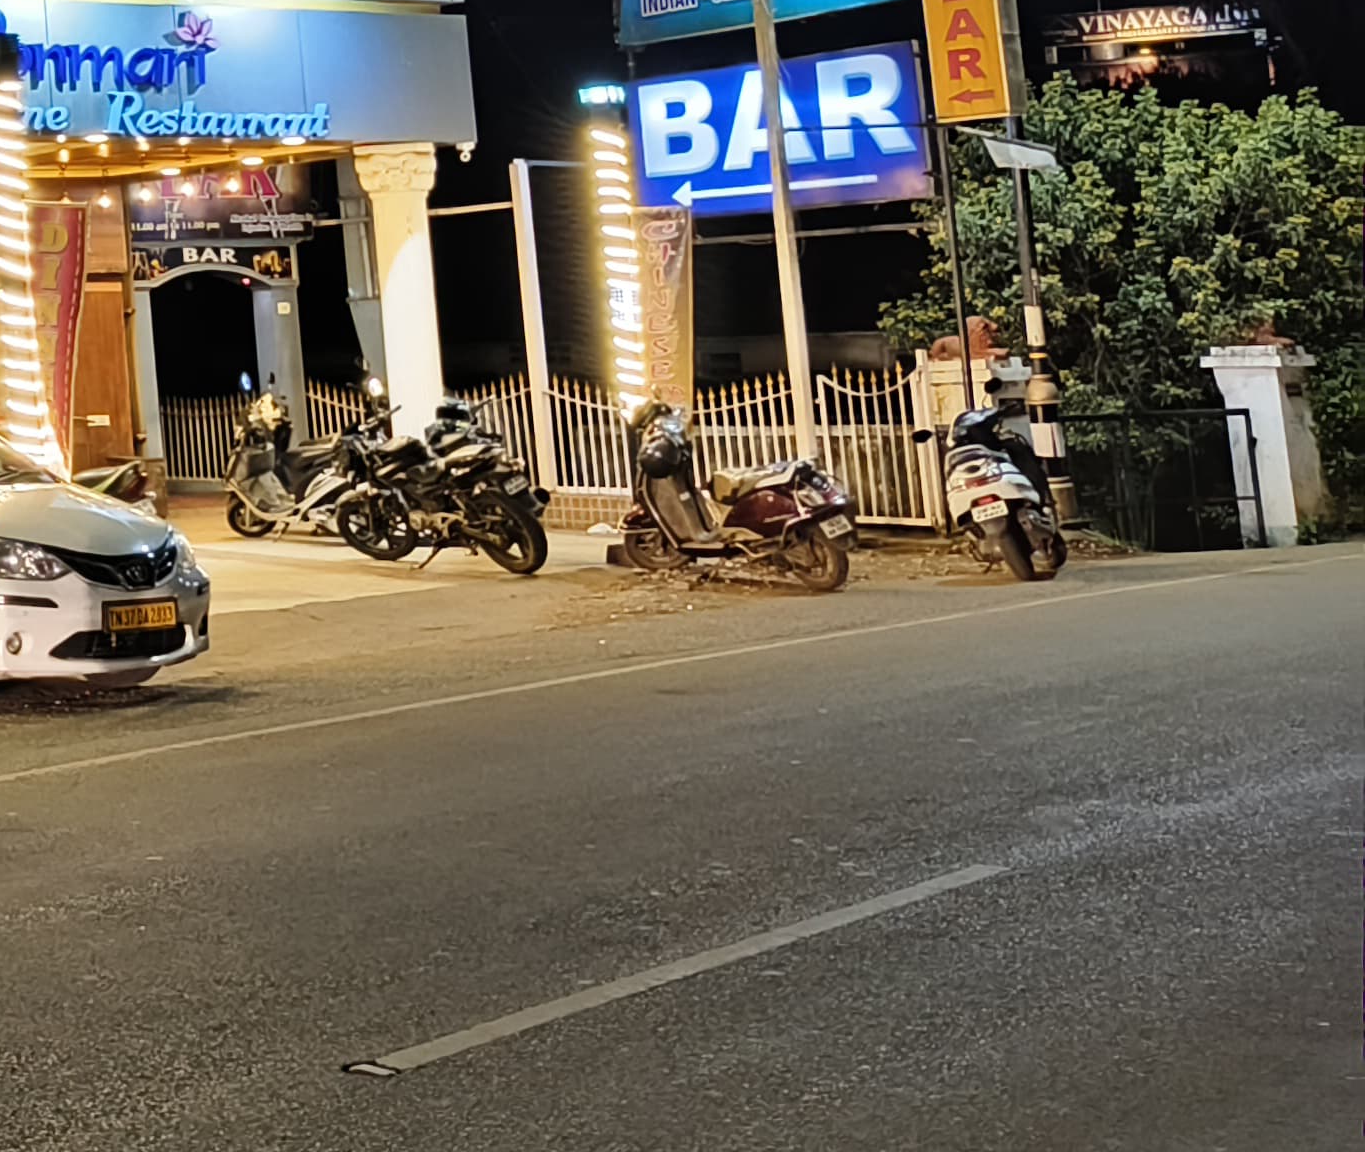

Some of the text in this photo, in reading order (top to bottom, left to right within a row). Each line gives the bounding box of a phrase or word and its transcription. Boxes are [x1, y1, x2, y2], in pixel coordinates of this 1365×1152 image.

[1077, 5, 1208, 34] VINAYAGA
[103, 91, 330, 138] Restaurant
[638, 53, 919, 179] BAR
[182, 247, 238, 264] BAR
